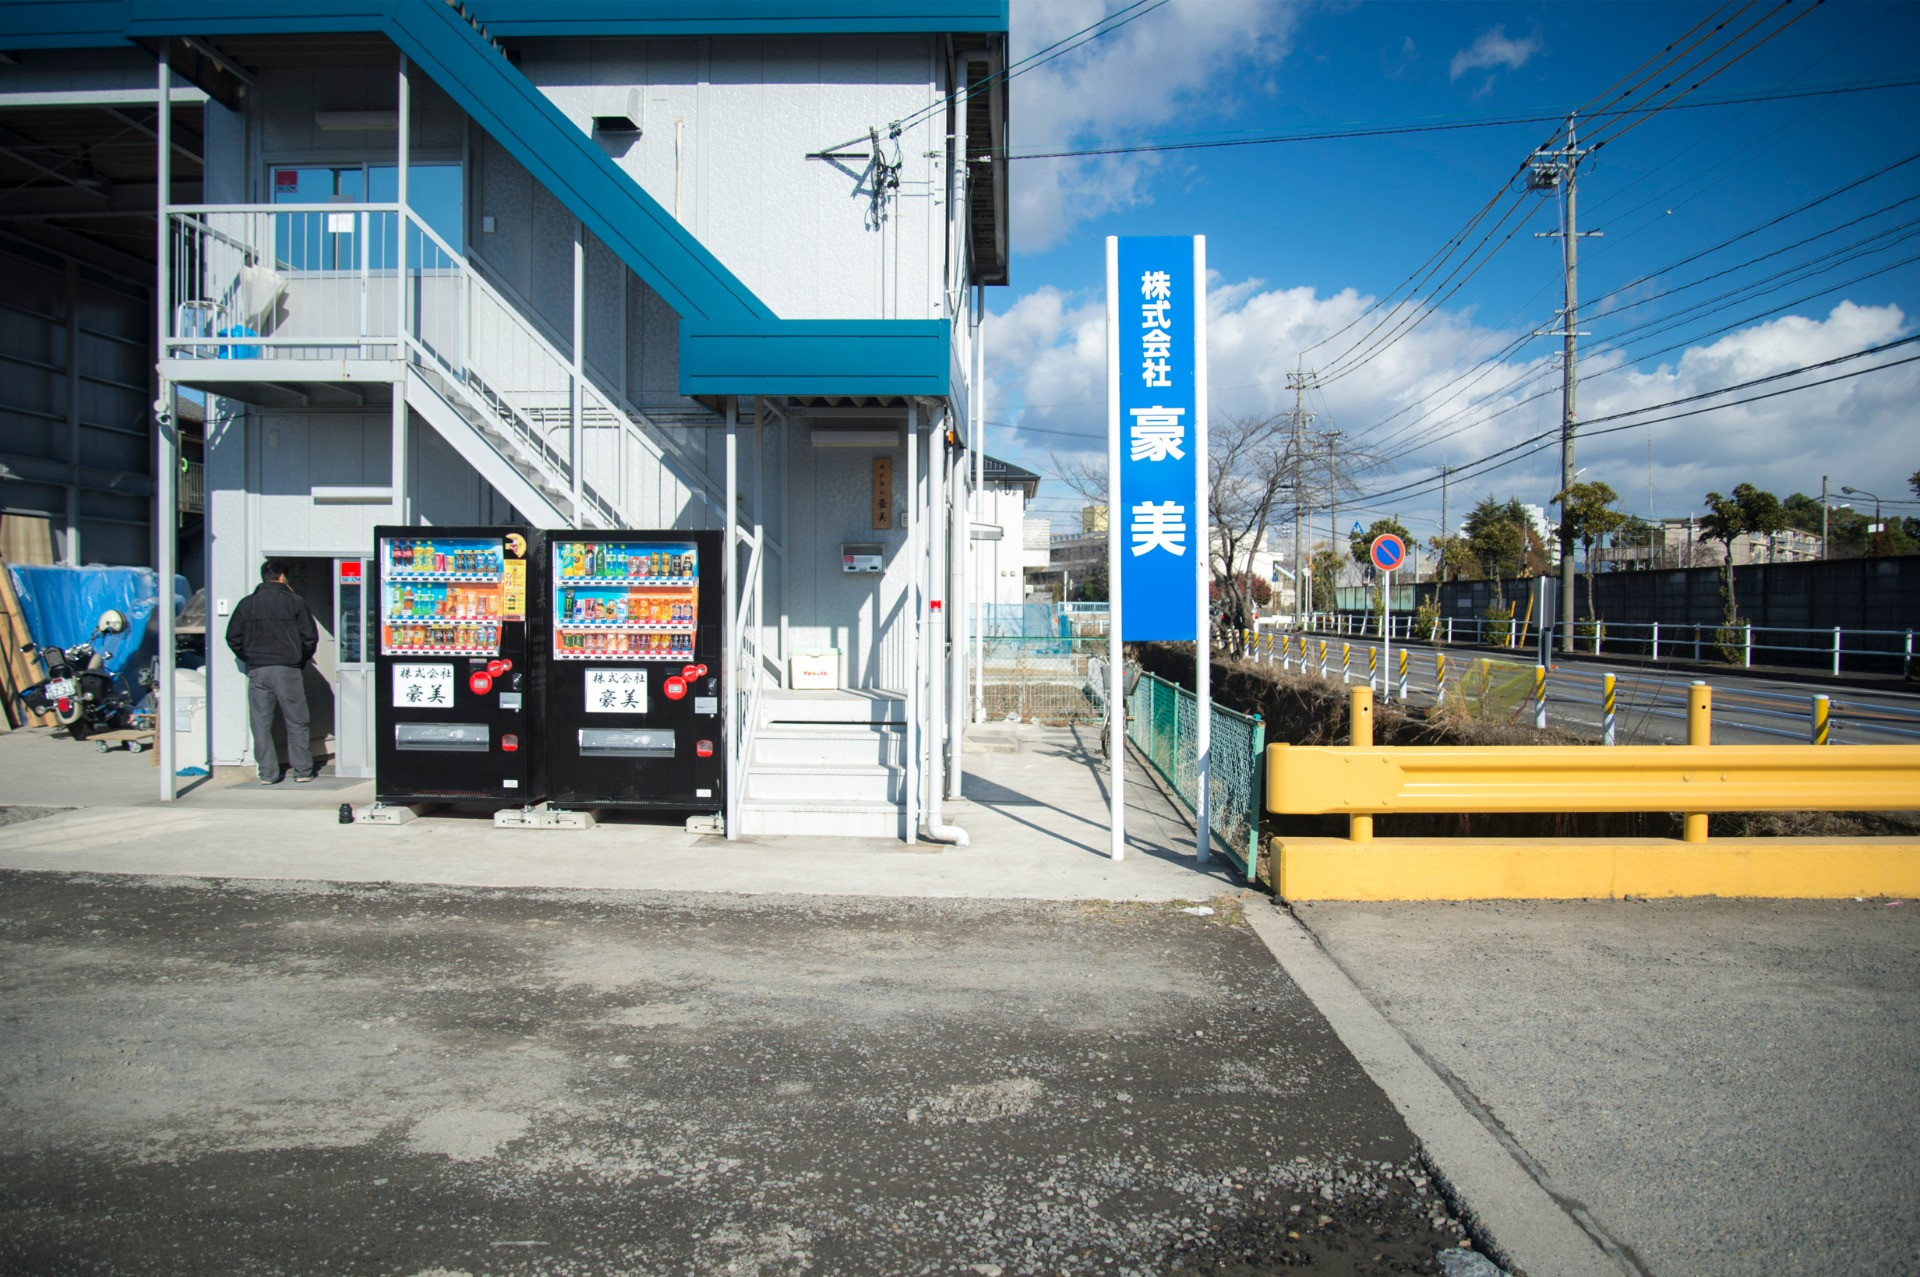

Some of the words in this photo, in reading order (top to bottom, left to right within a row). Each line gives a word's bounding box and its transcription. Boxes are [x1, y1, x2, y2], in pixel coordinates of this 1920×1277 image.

[1140, 270, 1172, 389] 株式会社
[1130, 405, 1187, 558] 豪美
[400, 668, 452, 680] 株式会社
[593, 672, 646, 684] 株式会社
[405, 684, 446, 704] 豪美
[599, 688, 640, 709] 豪美
